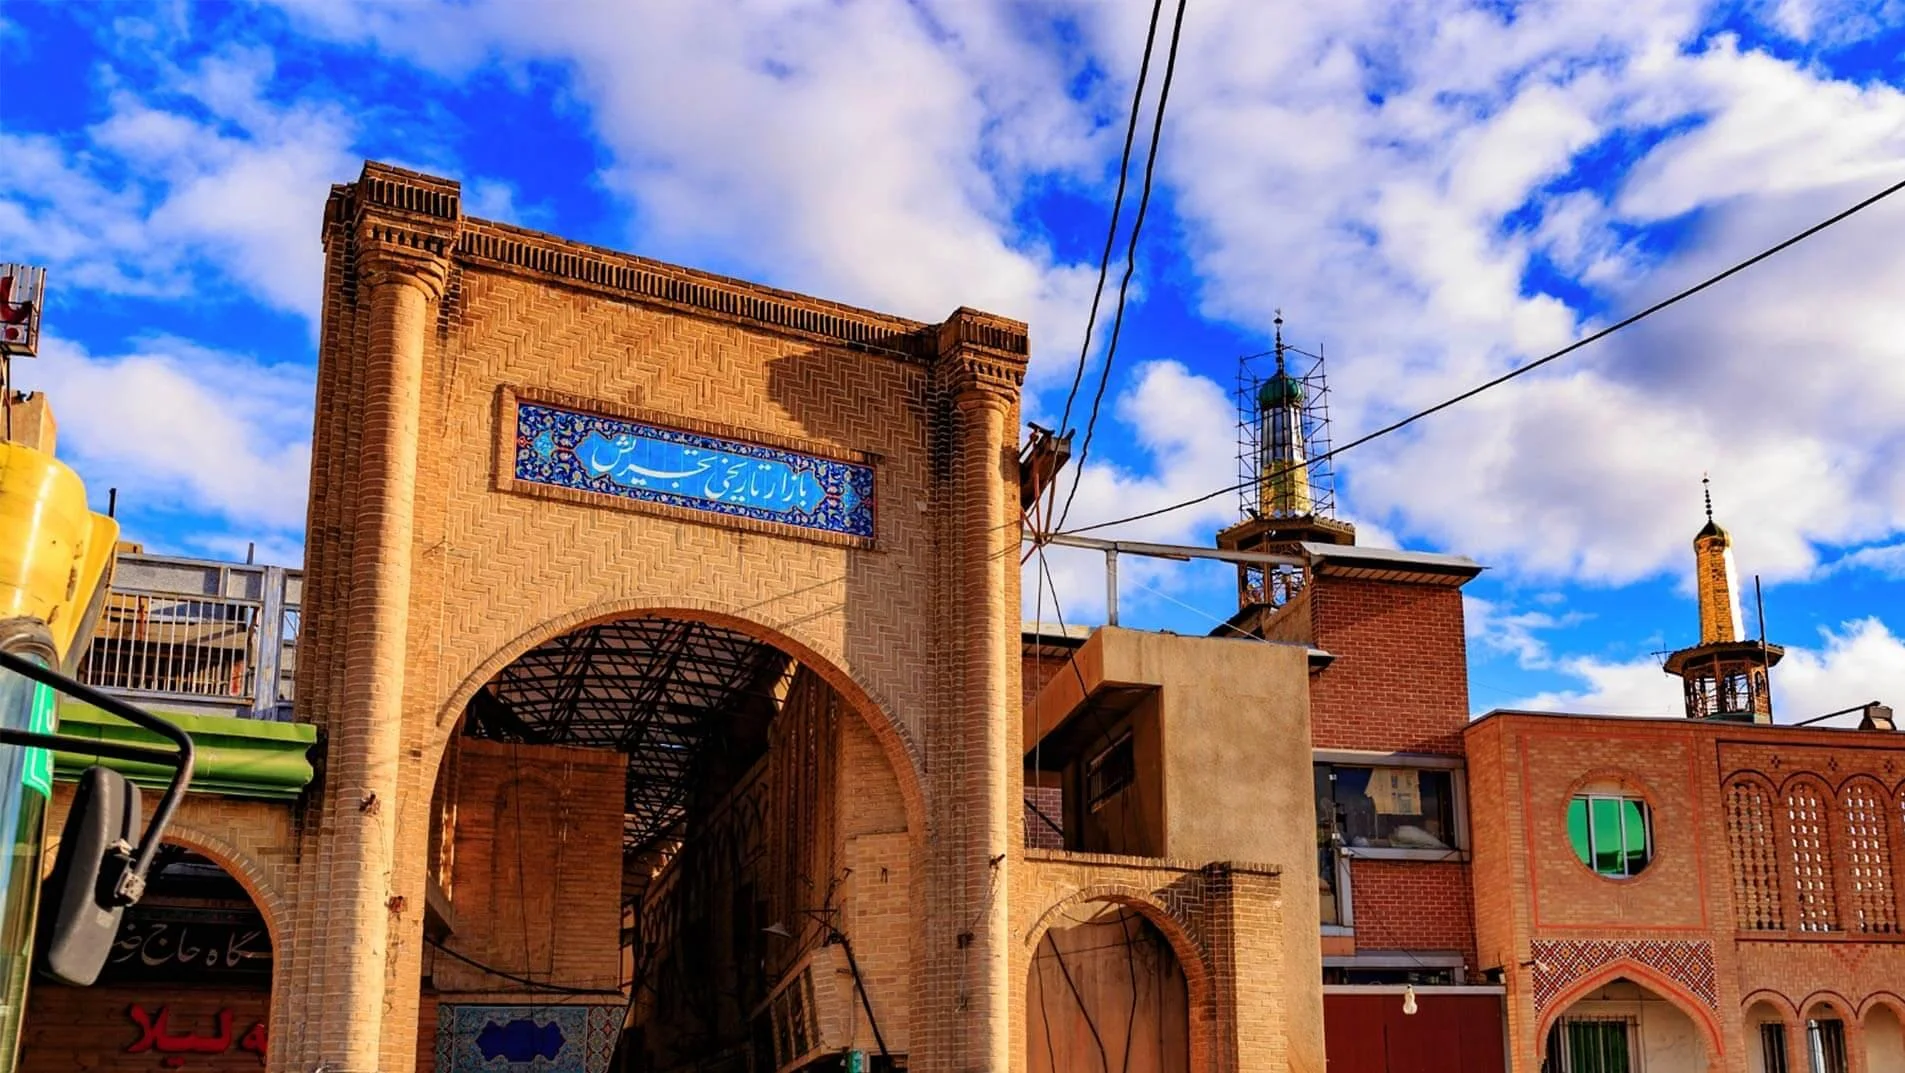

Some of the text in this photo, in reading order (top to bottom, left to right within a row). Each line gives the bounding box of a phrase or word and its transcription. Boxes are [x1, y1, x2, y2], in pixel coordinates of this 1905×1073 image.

[591, 436, 807, 507] بازار تاریخی تجریش
[112, 922, 143, 964] رض
[140, 923, 201, 966] حاج
[128, 1002, 233, 1067] لیلا
